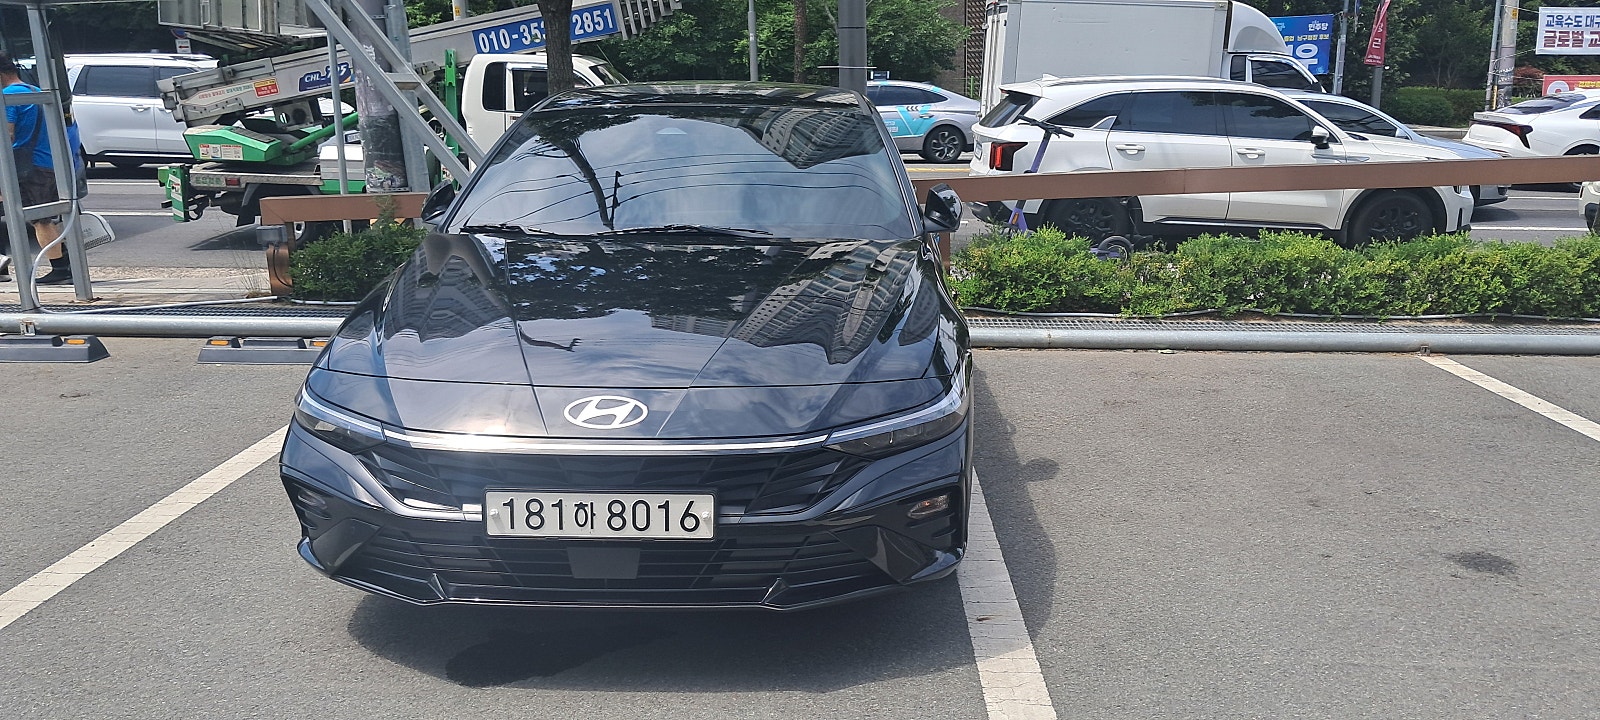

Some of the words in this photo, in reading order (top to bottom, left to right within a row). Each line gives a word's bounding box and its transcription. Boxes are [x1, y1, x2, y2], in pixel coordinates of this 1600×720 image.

[572, 8, 613, 36] 2851
[1545, 14, 1583, 28] 교육수도
[1543, 30, 1585, 48] 글로벌
[502, 498, 596, 531] 181하
[606, 499, 701, 533] 8016
